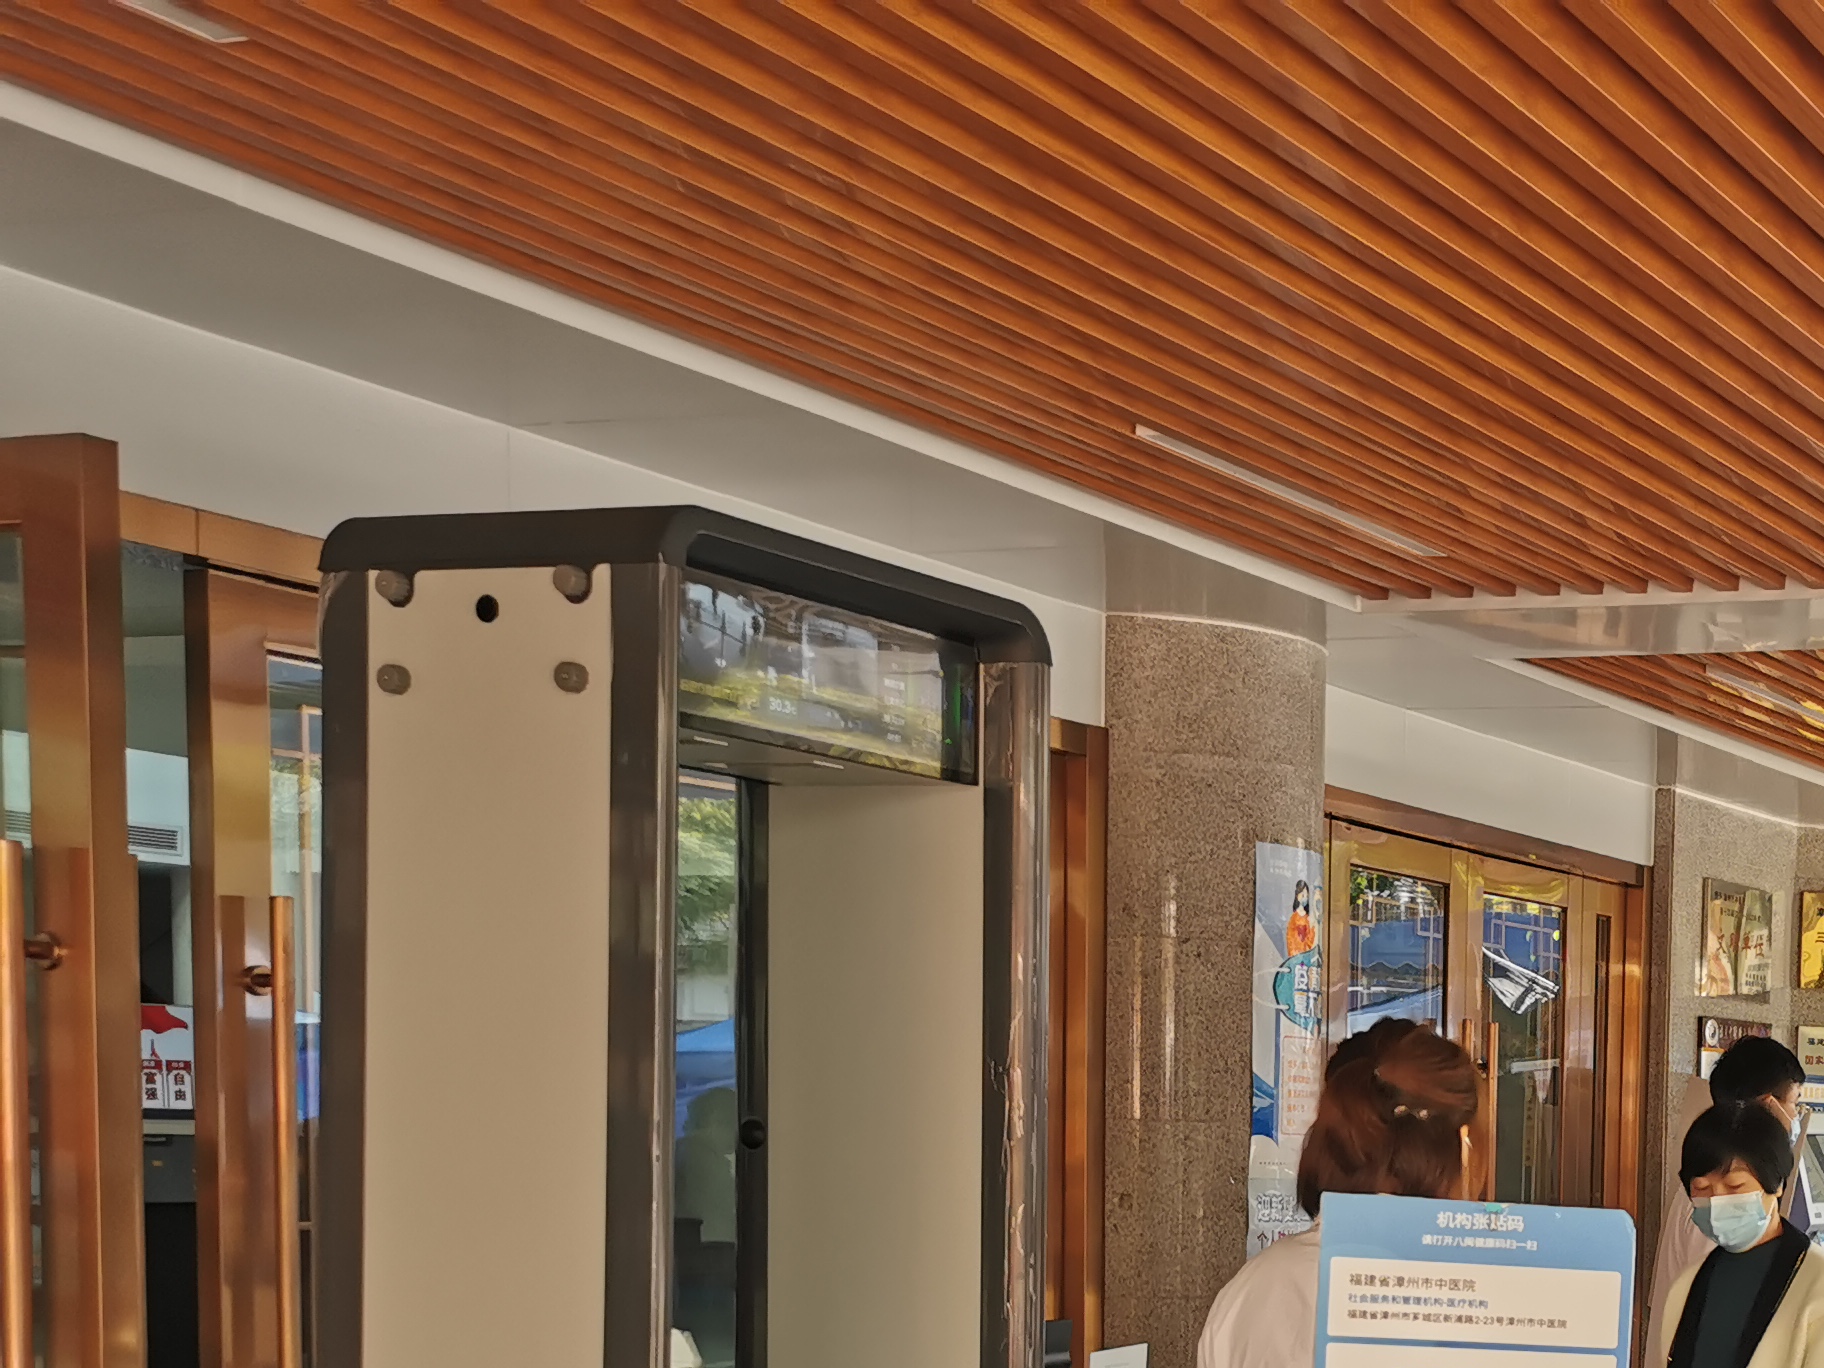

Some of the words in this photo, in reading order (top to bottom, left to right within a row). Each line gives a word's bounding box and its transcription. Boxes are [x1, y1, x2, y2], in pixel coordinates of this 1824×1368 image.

[174, 1071, 187, 1102] 自由
[1436, 1211, 1525, 1233] 机构张贴码
[1349, 1273, 1477, 1292] 福建省漳州市中医院
